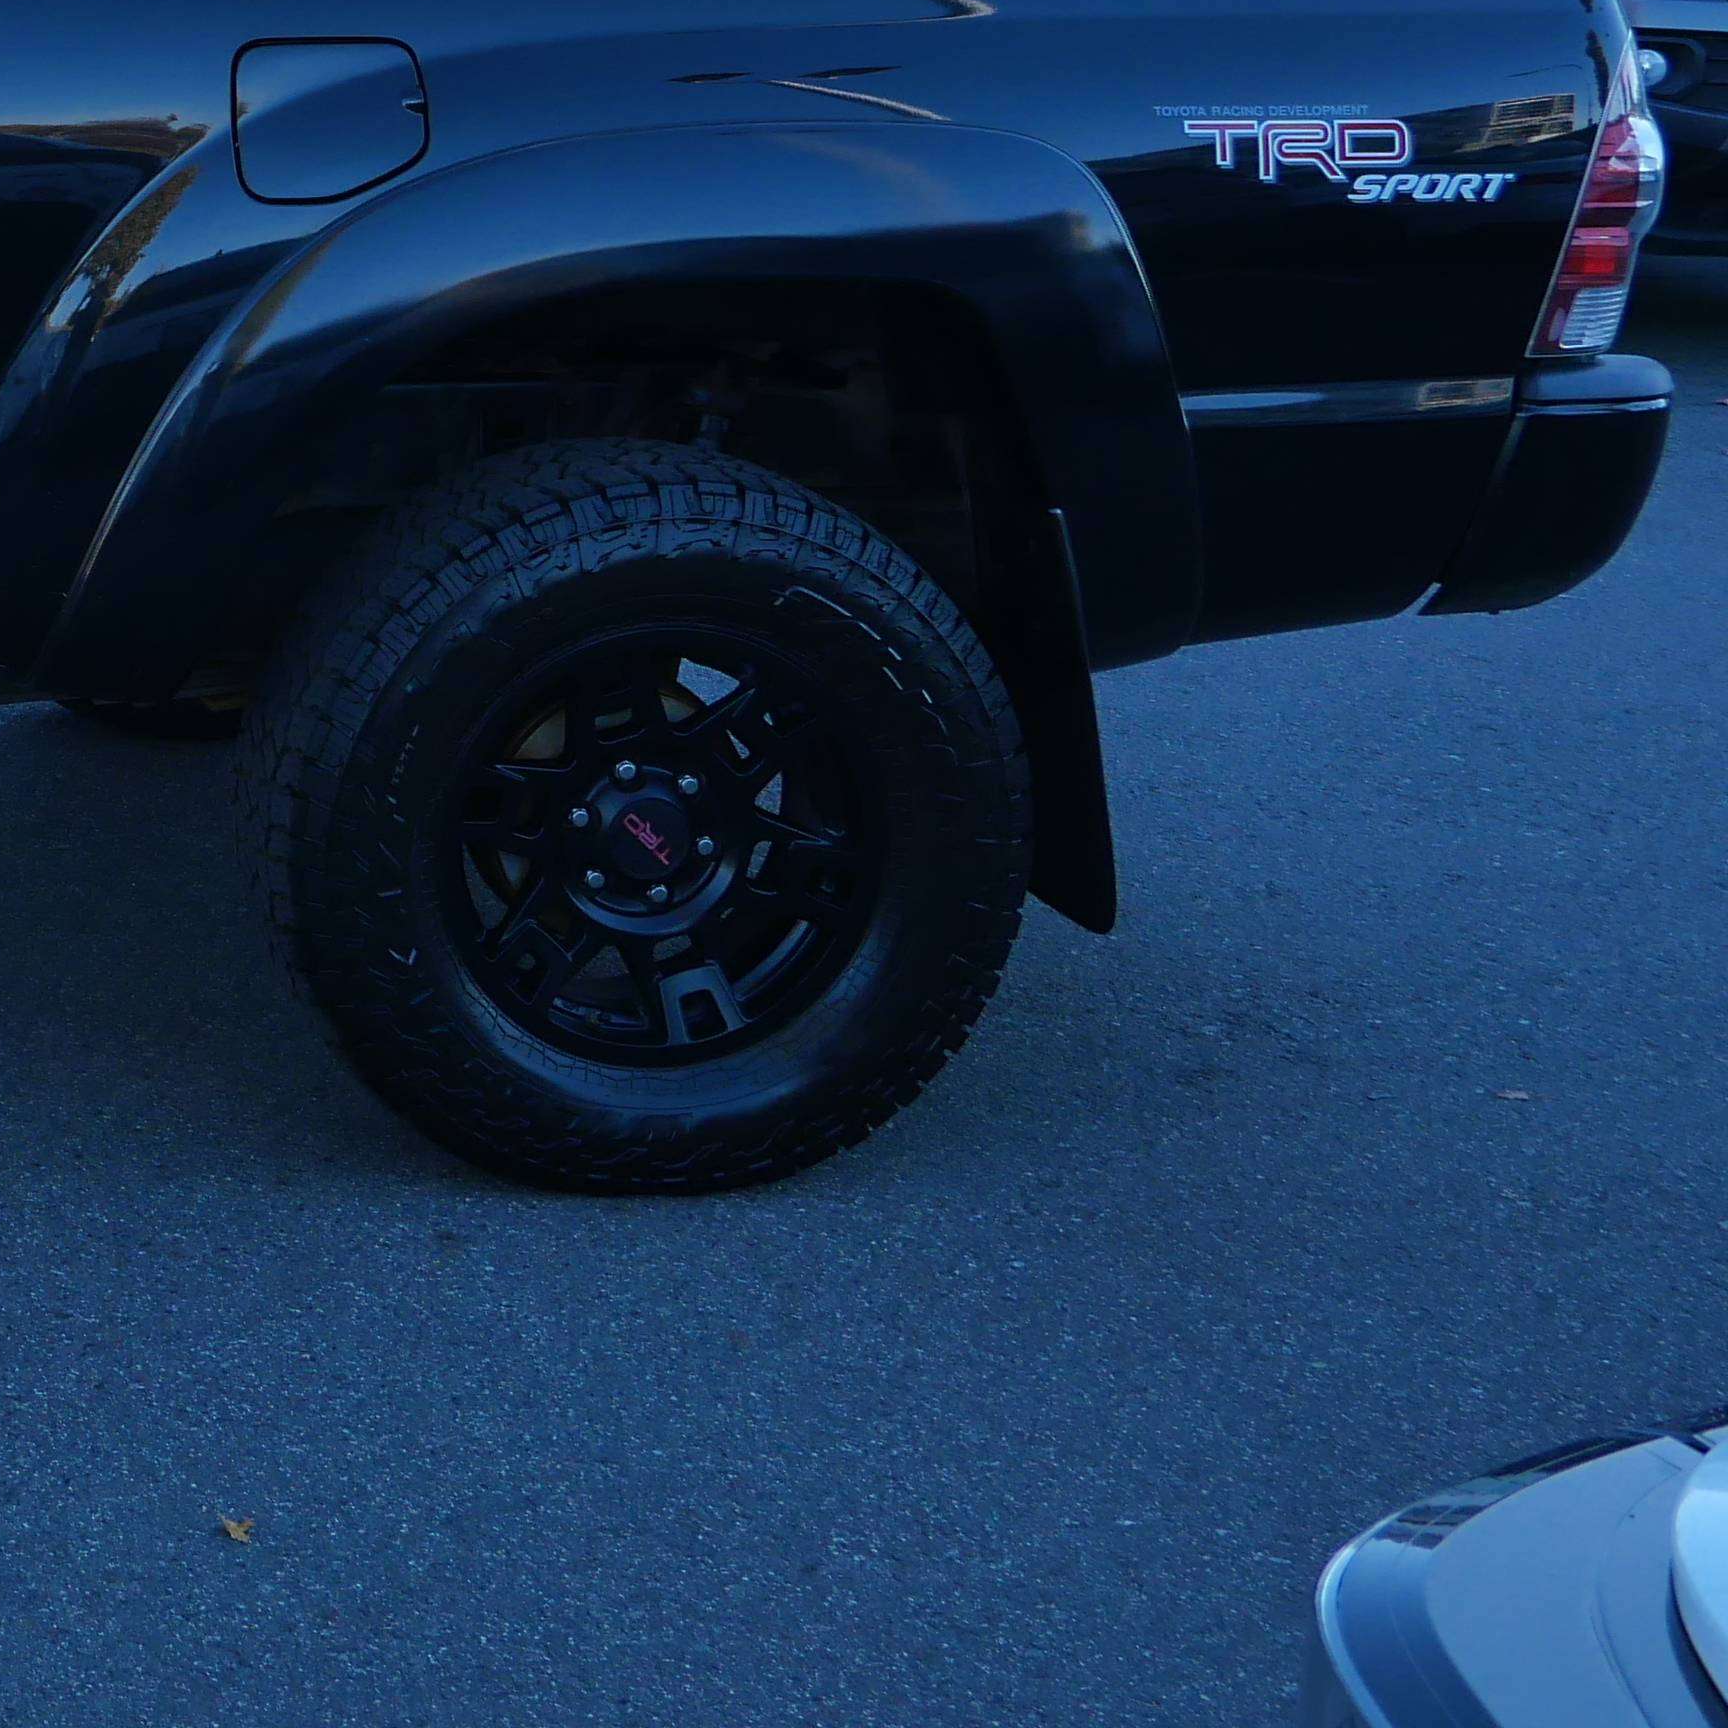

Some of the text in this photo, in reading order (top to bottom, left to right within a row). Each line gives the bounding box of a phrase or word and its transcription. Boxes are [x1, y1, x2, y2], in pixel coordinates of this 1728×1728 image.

[1152, 104, 1369, 117] TOYOTA RACING DEVELOPMENT
[1184, 120, 1409, 182] TRD
[1347, 174, 1516, 203] SPORT
